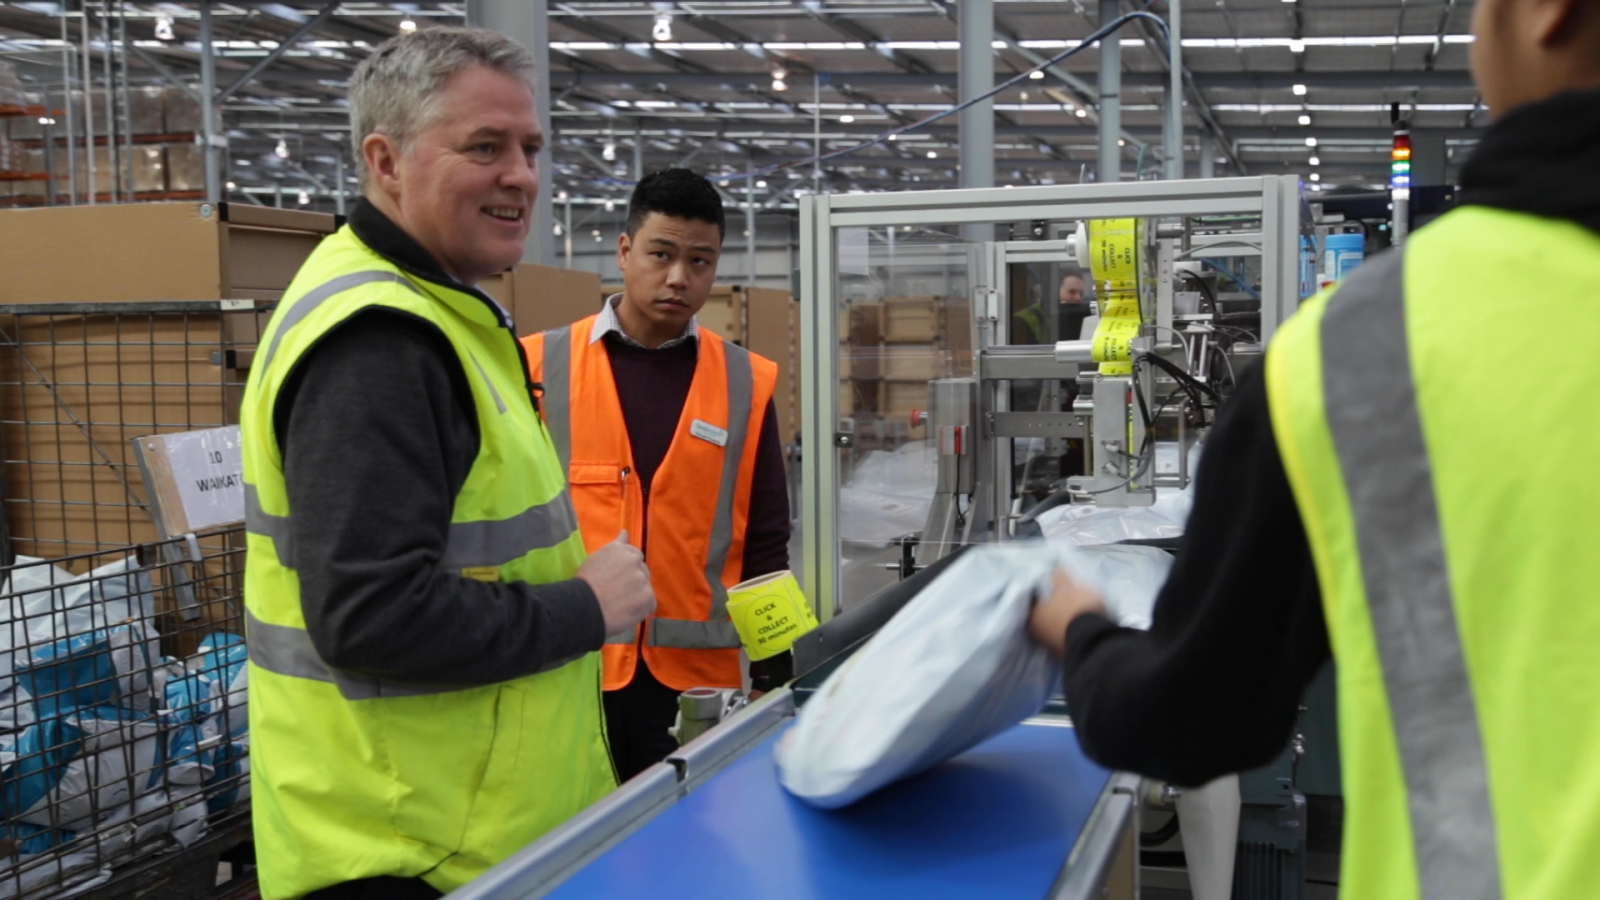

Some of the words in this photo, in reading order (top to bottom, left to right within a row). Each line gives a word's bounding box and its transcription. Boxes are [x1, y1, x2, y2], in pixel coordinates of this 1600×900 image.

[209, 451, 223, 464] 10
[754, 602, 776, 616] CLICK
[757, 616, 789, 635] COLLECT
[767, 623, 798, 641] minutes
